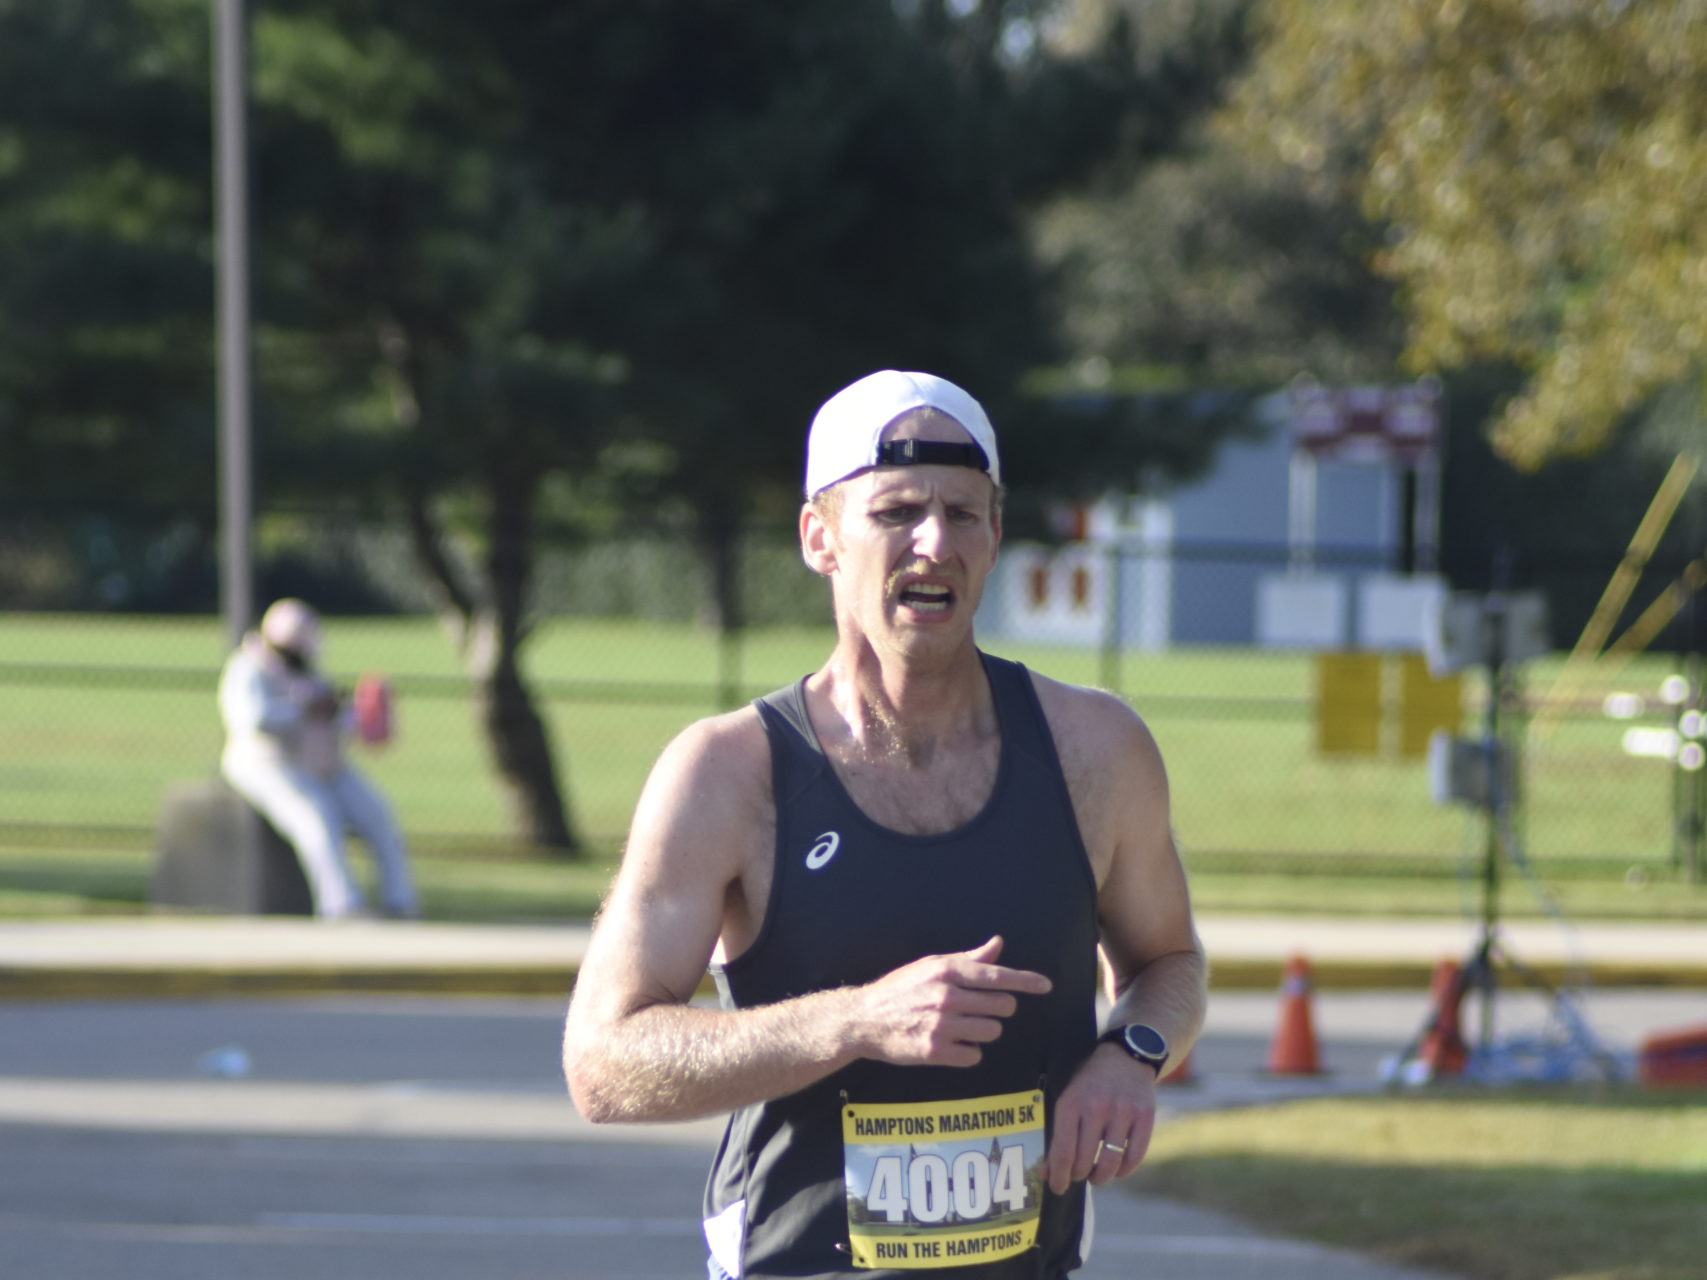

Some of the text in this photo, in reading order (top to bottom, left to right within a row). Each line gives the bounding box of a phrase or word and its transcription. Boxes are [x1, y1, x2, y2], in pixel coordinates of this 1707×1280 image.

[855, 1104, 1035, 1136] HAMPTONS MARATHON 5K
[867, 1144, 1028, 1223] 4004
[876, 1230, 1022, 1259] RUN THE HAMPTONS
